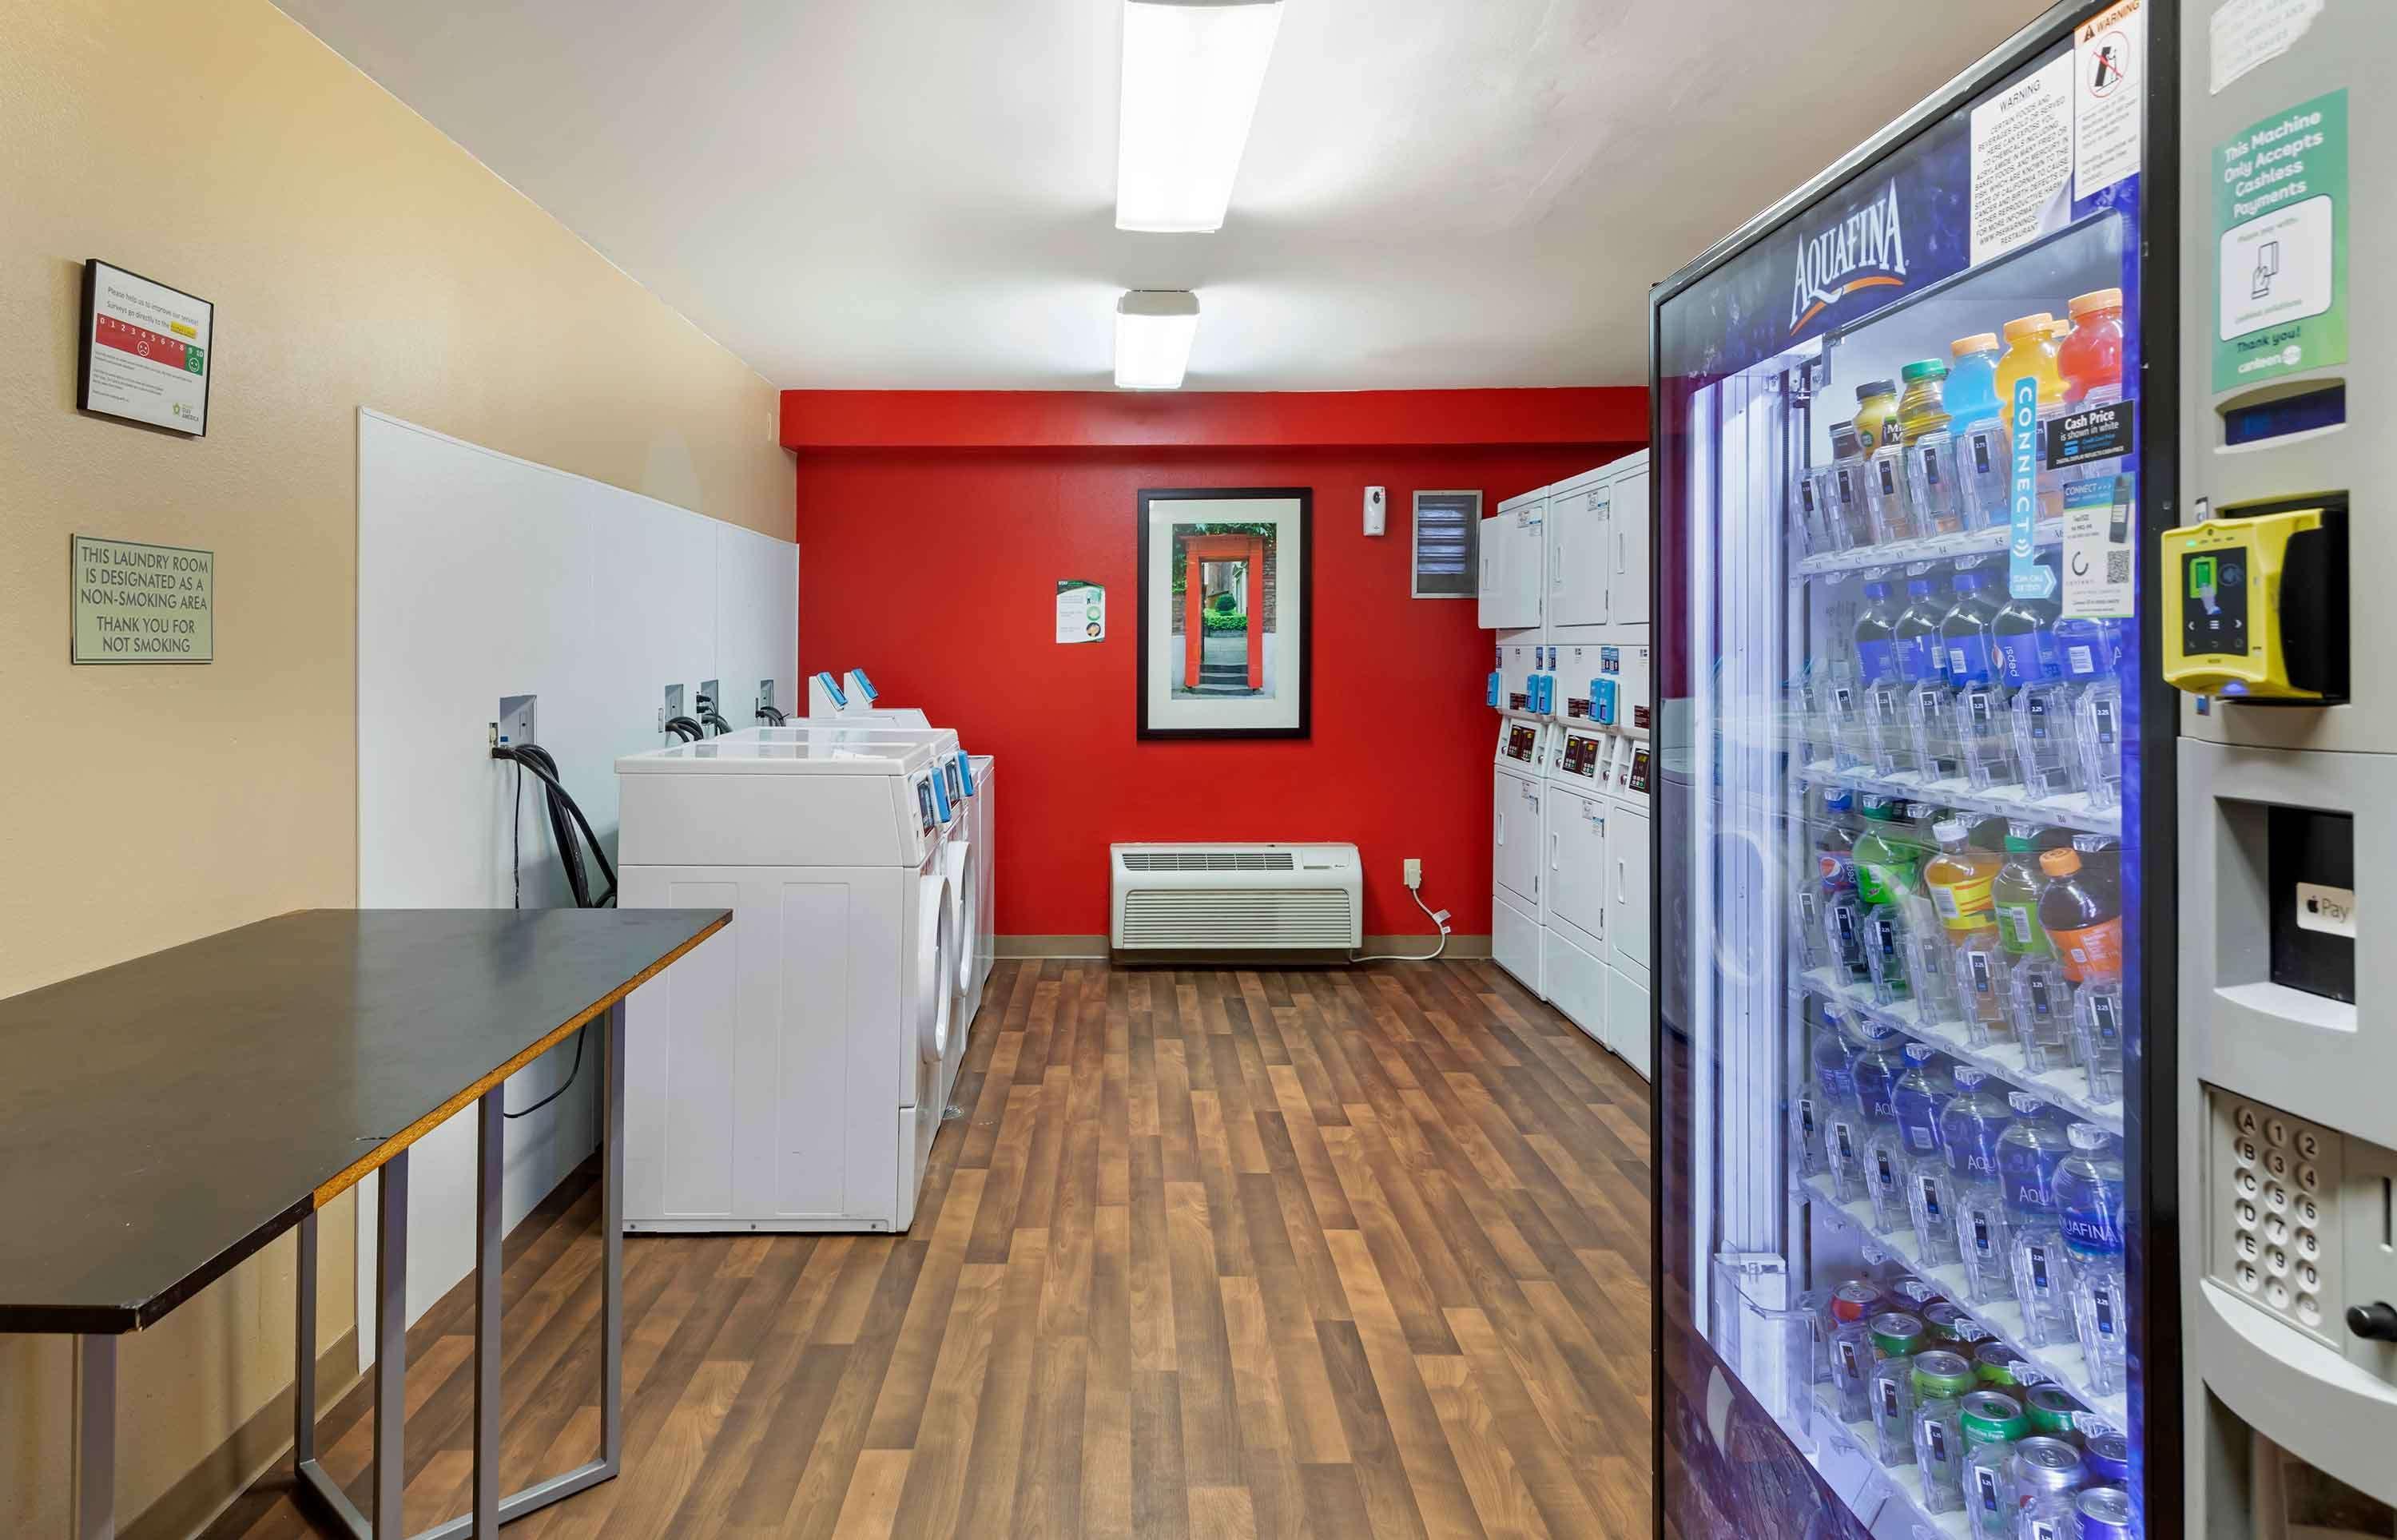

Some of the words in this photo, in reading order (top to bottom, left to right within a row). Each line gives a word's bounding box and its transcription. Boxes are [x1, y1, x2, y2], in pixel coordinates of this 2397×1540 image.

[2097, 2, 2140, 33] WARNING
[2000, 78, 2040, 113] WARNING
[2224, 140, 2248, 163] This
[2251, 111, 2321, 149] Machine
[2224, 161, 2252, 183] Only
[2256, 131, 2323, 169] Accepts
[2236, 161, 2304, 197] Cashless
[2233, 180, 2307, 218] Payments
[1790, 177, 1906, 329] AQUAFINA
[2237, 335, 2269, 352] Thank
[2272, 326, 2300, 346] you!
[2065, 415, 2088, 430] Cash
[2089, 410, 2115, 424] Price
[2068, 428, 2090, 439] shown
[2091, 425, 2098, 434] in
[2099, 421, 2120, 432] white
[2016, 386, 2032, 534] CONNECT
[81, 547, 109, 564] THIS
[114, 550, 169, 569] LAUNDRY
[173, 557, 208, 573] ROOM
[85, 568, 97, 584] IS
[101, 570, 176, 589] DESIGNATED
[179, 577, 193, 591] AS
[196, 579, 204, 591] A
[81, 589, 177, 609] NON-SMOKING
[180, 596, 208, 610] AREA
[97, 616, 140, 632] THANK
[142, 618, 169, 633] YOU
[173, 620, 195, 634] FOR
[102, 637, 130, 653] NOT
[133, 637, 190, 653] SMOKING
[2004, 645, 2020, 677] pepsi
[2321, 898, 2350, 923] Pay
[2244, 1113, 2254, 1129] A
[2275, 1125, 2281, 1141] 1
[2305, 1137, 2316, 1154] 2
[2244, 1144, 2256, 1160] B
[2276, 1157, 2284, 1173] 3
[2305, 1169, 2315, 1185] 4
[2244, 1175, 2256, 1191] C
[2276, 1189, 2284, 1205] 5
[2306, 1203, 2315, 1220] 6
[2245, 1205, 2256, 1221] D
[2276, 1219, 2284, 1235] 7
[2307, 1236, 2316, 1252] 8
[2245, 1236, 2256, 1254] E
[2276, 1251, 2284, 1268] 9
[2246, 1267, 2256, 1283] F
